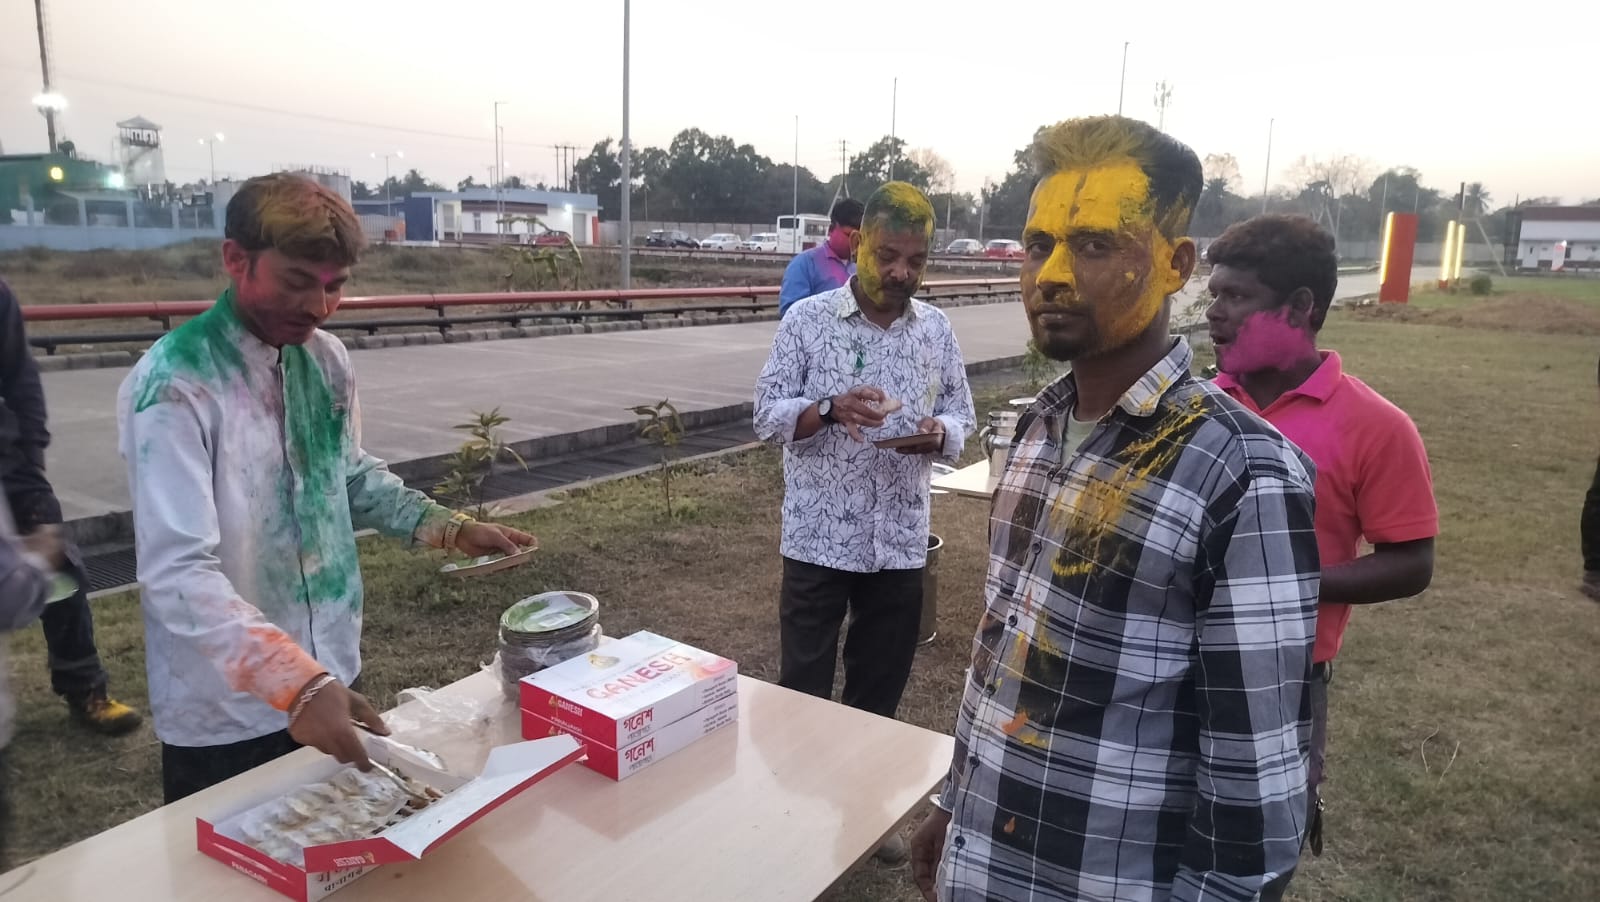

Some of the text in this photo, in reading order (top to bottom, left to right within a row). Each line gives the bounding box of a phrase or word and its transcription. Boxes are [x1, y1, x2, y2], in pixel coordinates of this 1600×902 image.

[586, 652, 692, 700] GANESH
[557, 698, 583, 717] GANESH
[623, 707, 654, 732] গনেশ
[625, 737, 655, 762] গনেশ
